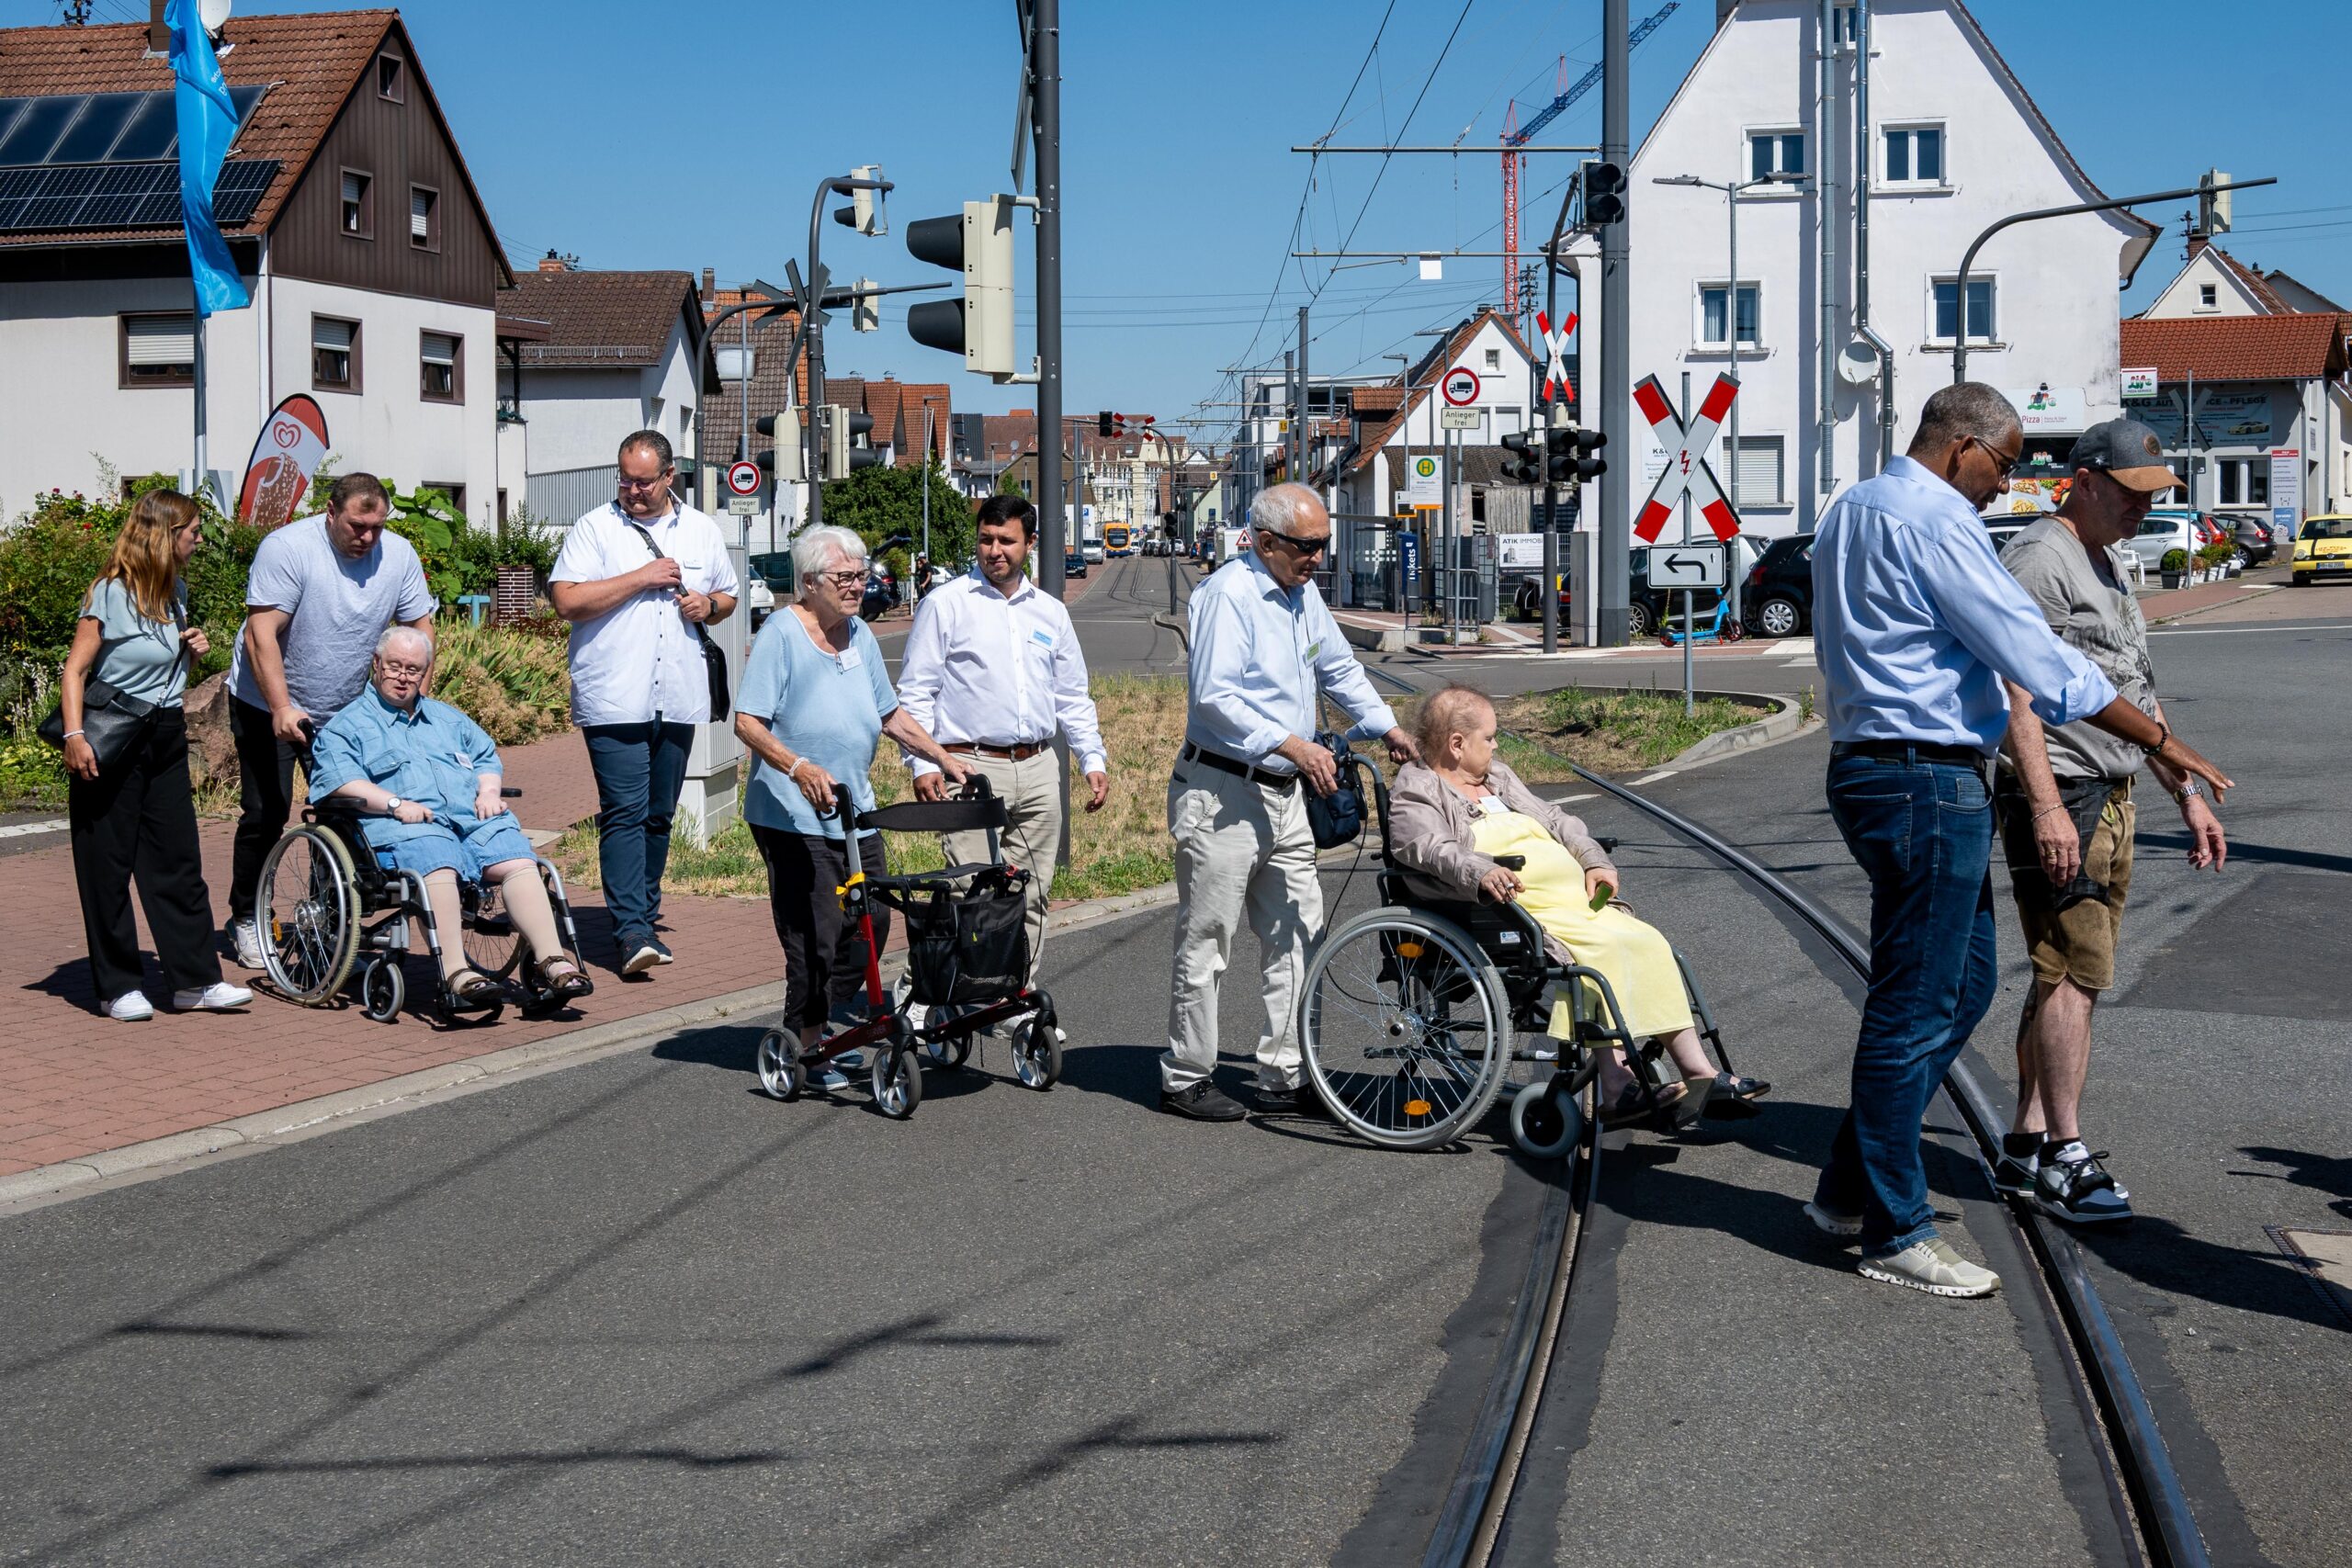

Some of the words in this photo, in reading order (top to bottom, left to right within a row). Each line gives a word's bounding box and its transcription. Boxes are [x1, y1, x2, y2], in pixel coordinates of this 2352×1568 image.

[2120, 398, 2151, 407] K&G
[2230, 396, 2267, 405] PFLEGE
[1445, 411, 1476, 420] Anlieger
[2021, 415, 2041, 423] Pizza
